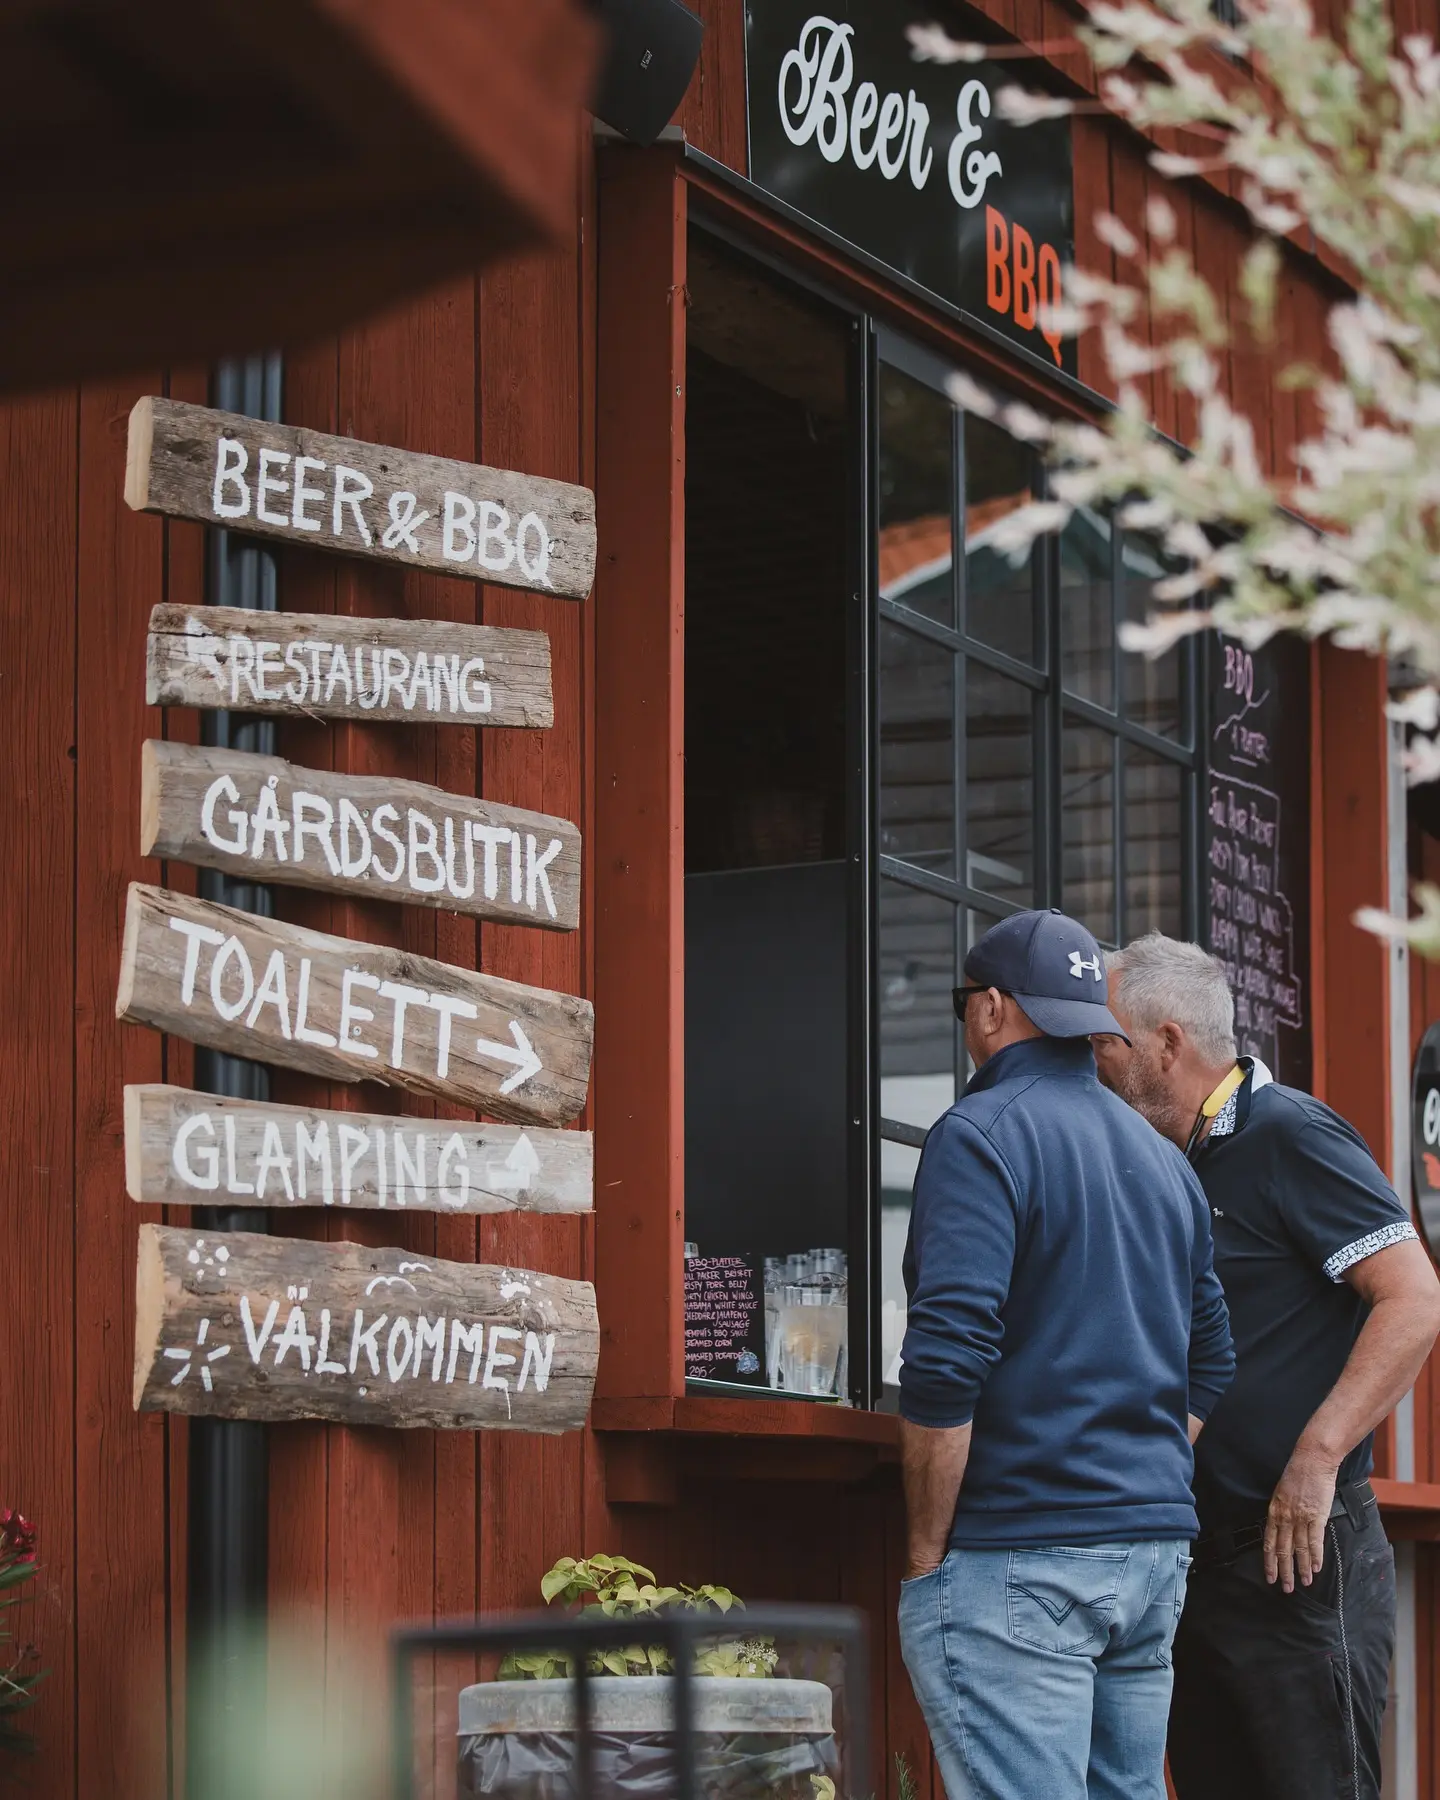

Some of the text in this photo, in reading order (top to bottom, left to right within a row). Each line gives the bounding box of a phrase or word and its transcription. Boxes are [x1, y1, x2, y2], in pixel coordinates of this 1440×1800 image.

[779, 16, 1003, 208] Beer &
[986, 204, 1062, 367] BBQ
[213, 438, 555, 589] BEER & BBQ
[227, 635, 492, 714] RESTAURANG
[202, 775, 562, 920] GÅRDSBUTIK
[170, 917, 478, 1078] TOALETT
[172, 1113, 470, 1207] GLAMPING
[684, 1281, 702, 1292] RISPY
[728, 1280, 747, 1291] BELLY
[714, 1329, 728, 1338] BBQ
[730, 1329, 748, 1338] SAUCE
[715, 1301, 735, 1310] WHITE
[738, 1301, 758, 1310] SAUCE
[732, 1290, 753, 1300] WINGS
[240, 1285, 555, 1393] VÄLKOMMEN
